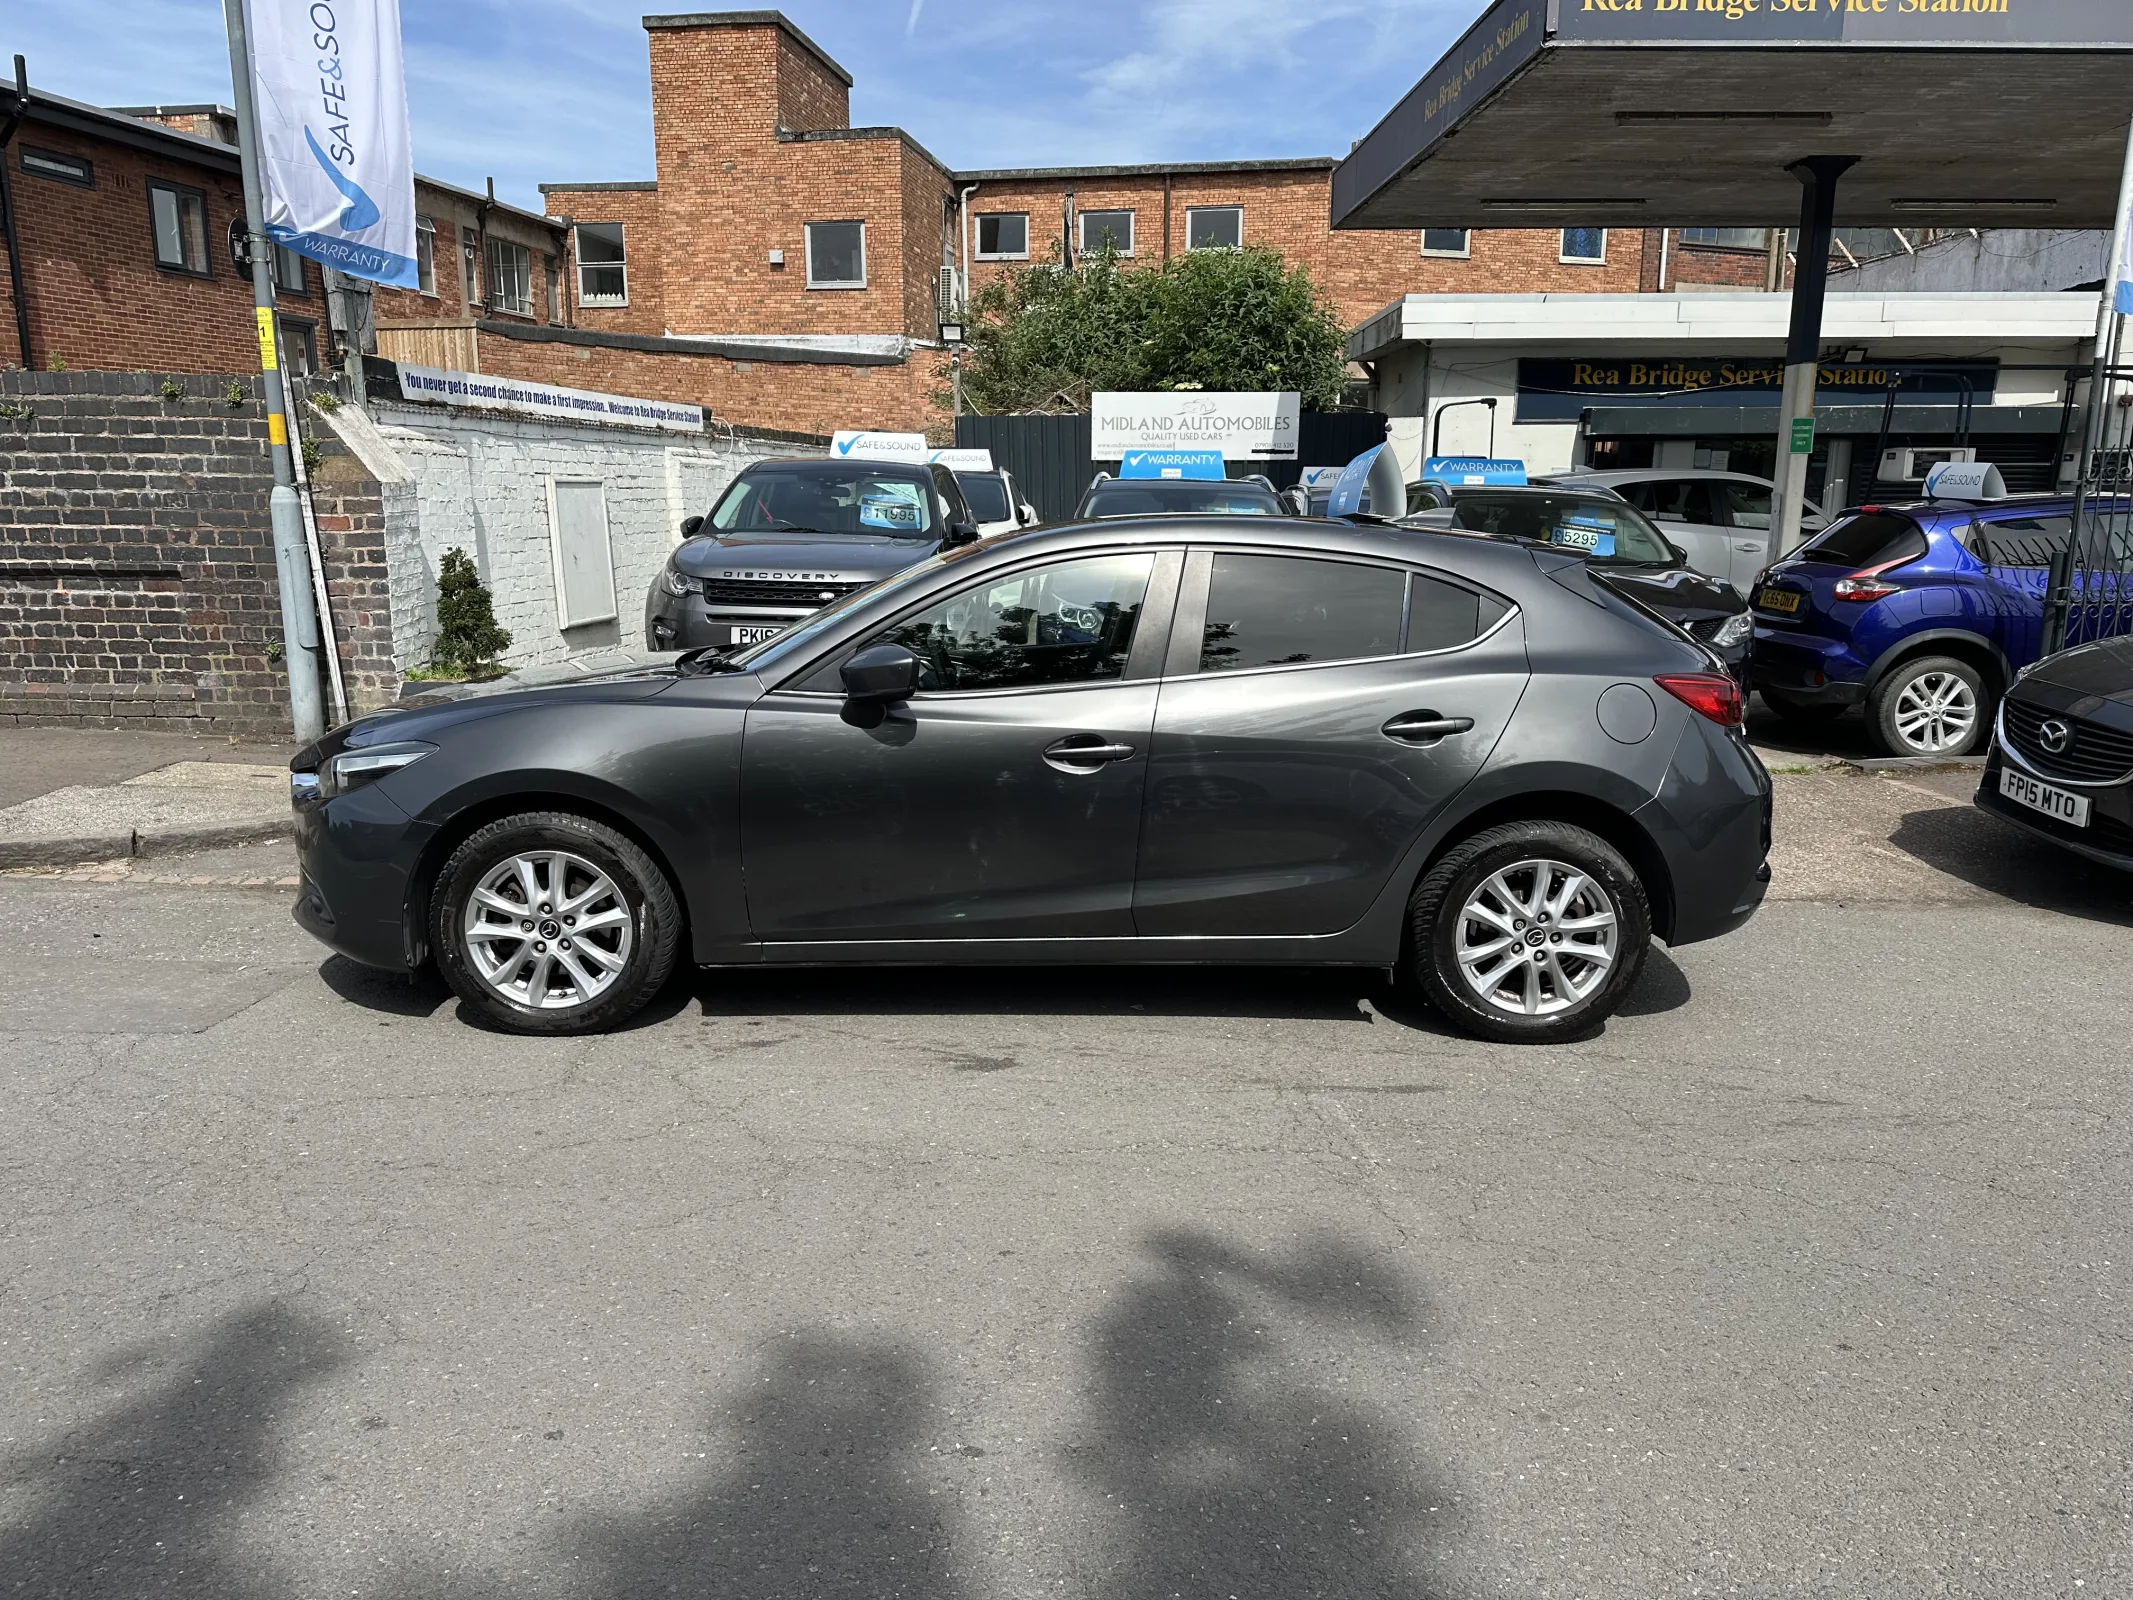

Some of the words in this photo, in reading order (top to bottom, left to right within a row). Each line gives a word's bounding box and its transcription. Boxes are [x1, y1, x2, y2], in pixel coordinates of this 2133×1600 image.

[1424, 98, 1437, 122] Rea
[1439, 74, 1462, 109] Bridge
[1463, 43, 1494, 85] Service
[1495, 10, 1529, 55] Station
[310, 0, 354, 165] SAFE&SO
[304, 235, 390, 272] WARRANTY
[259, 326, 266, 338] 1
[1572, 363, 1620, 386] Rea
[1628, 363, 1712, 390] Bridge
[1719, 363, 1785, 386] Servi
[1818, 368, 1903, 385] Statio
[405, 371, 422, 389] You
[423, 376, 447, 392] never
[448, 380, 462, 394] get
[463, 383, 468, 394] a
[469, 384, 497, 398] second
[498, 386, 524, 401] chance
[525, 390, 532, 403] to
[533, 391, 551, 405] make
[552, 396, 557, 406] a
[557, 393, 571, 407] first
[608, 401, 634, 416] Welcome
[634, 405, 640, 417] to
[640, 406, 650, 418] Rea
[650, 406, 667, 421] Bridge
[667, 408, 684, 422] Service
[684, 410, 700, 424] Station
[1101, 416, 1174, 431] MIDLAND
[1178, 416, 1291, 431] AUTOMOBILES
[1141, 432, 1178, 441] QUALITY
[1179, 432, 1199, 441] USED
[1201, 432, 1223, 441] CARS
[856, 440, 922, 451] SAFE&SOUND
[939, 454, 987, 462] SAFE&SOUND
[1147, 455, 1217, 465] WARRANTY
[1449, 461, 1519, 474] WARRANTY
[1320, 472, 1341, 480] SAFE
[1939, 474, 1981, 486] SAFE&SOUND
[723, 571, 840, 580] DISCOVERY
[2007, 772, 2039, 804] FP15
[2041, 787, 2076, 818] MTO
